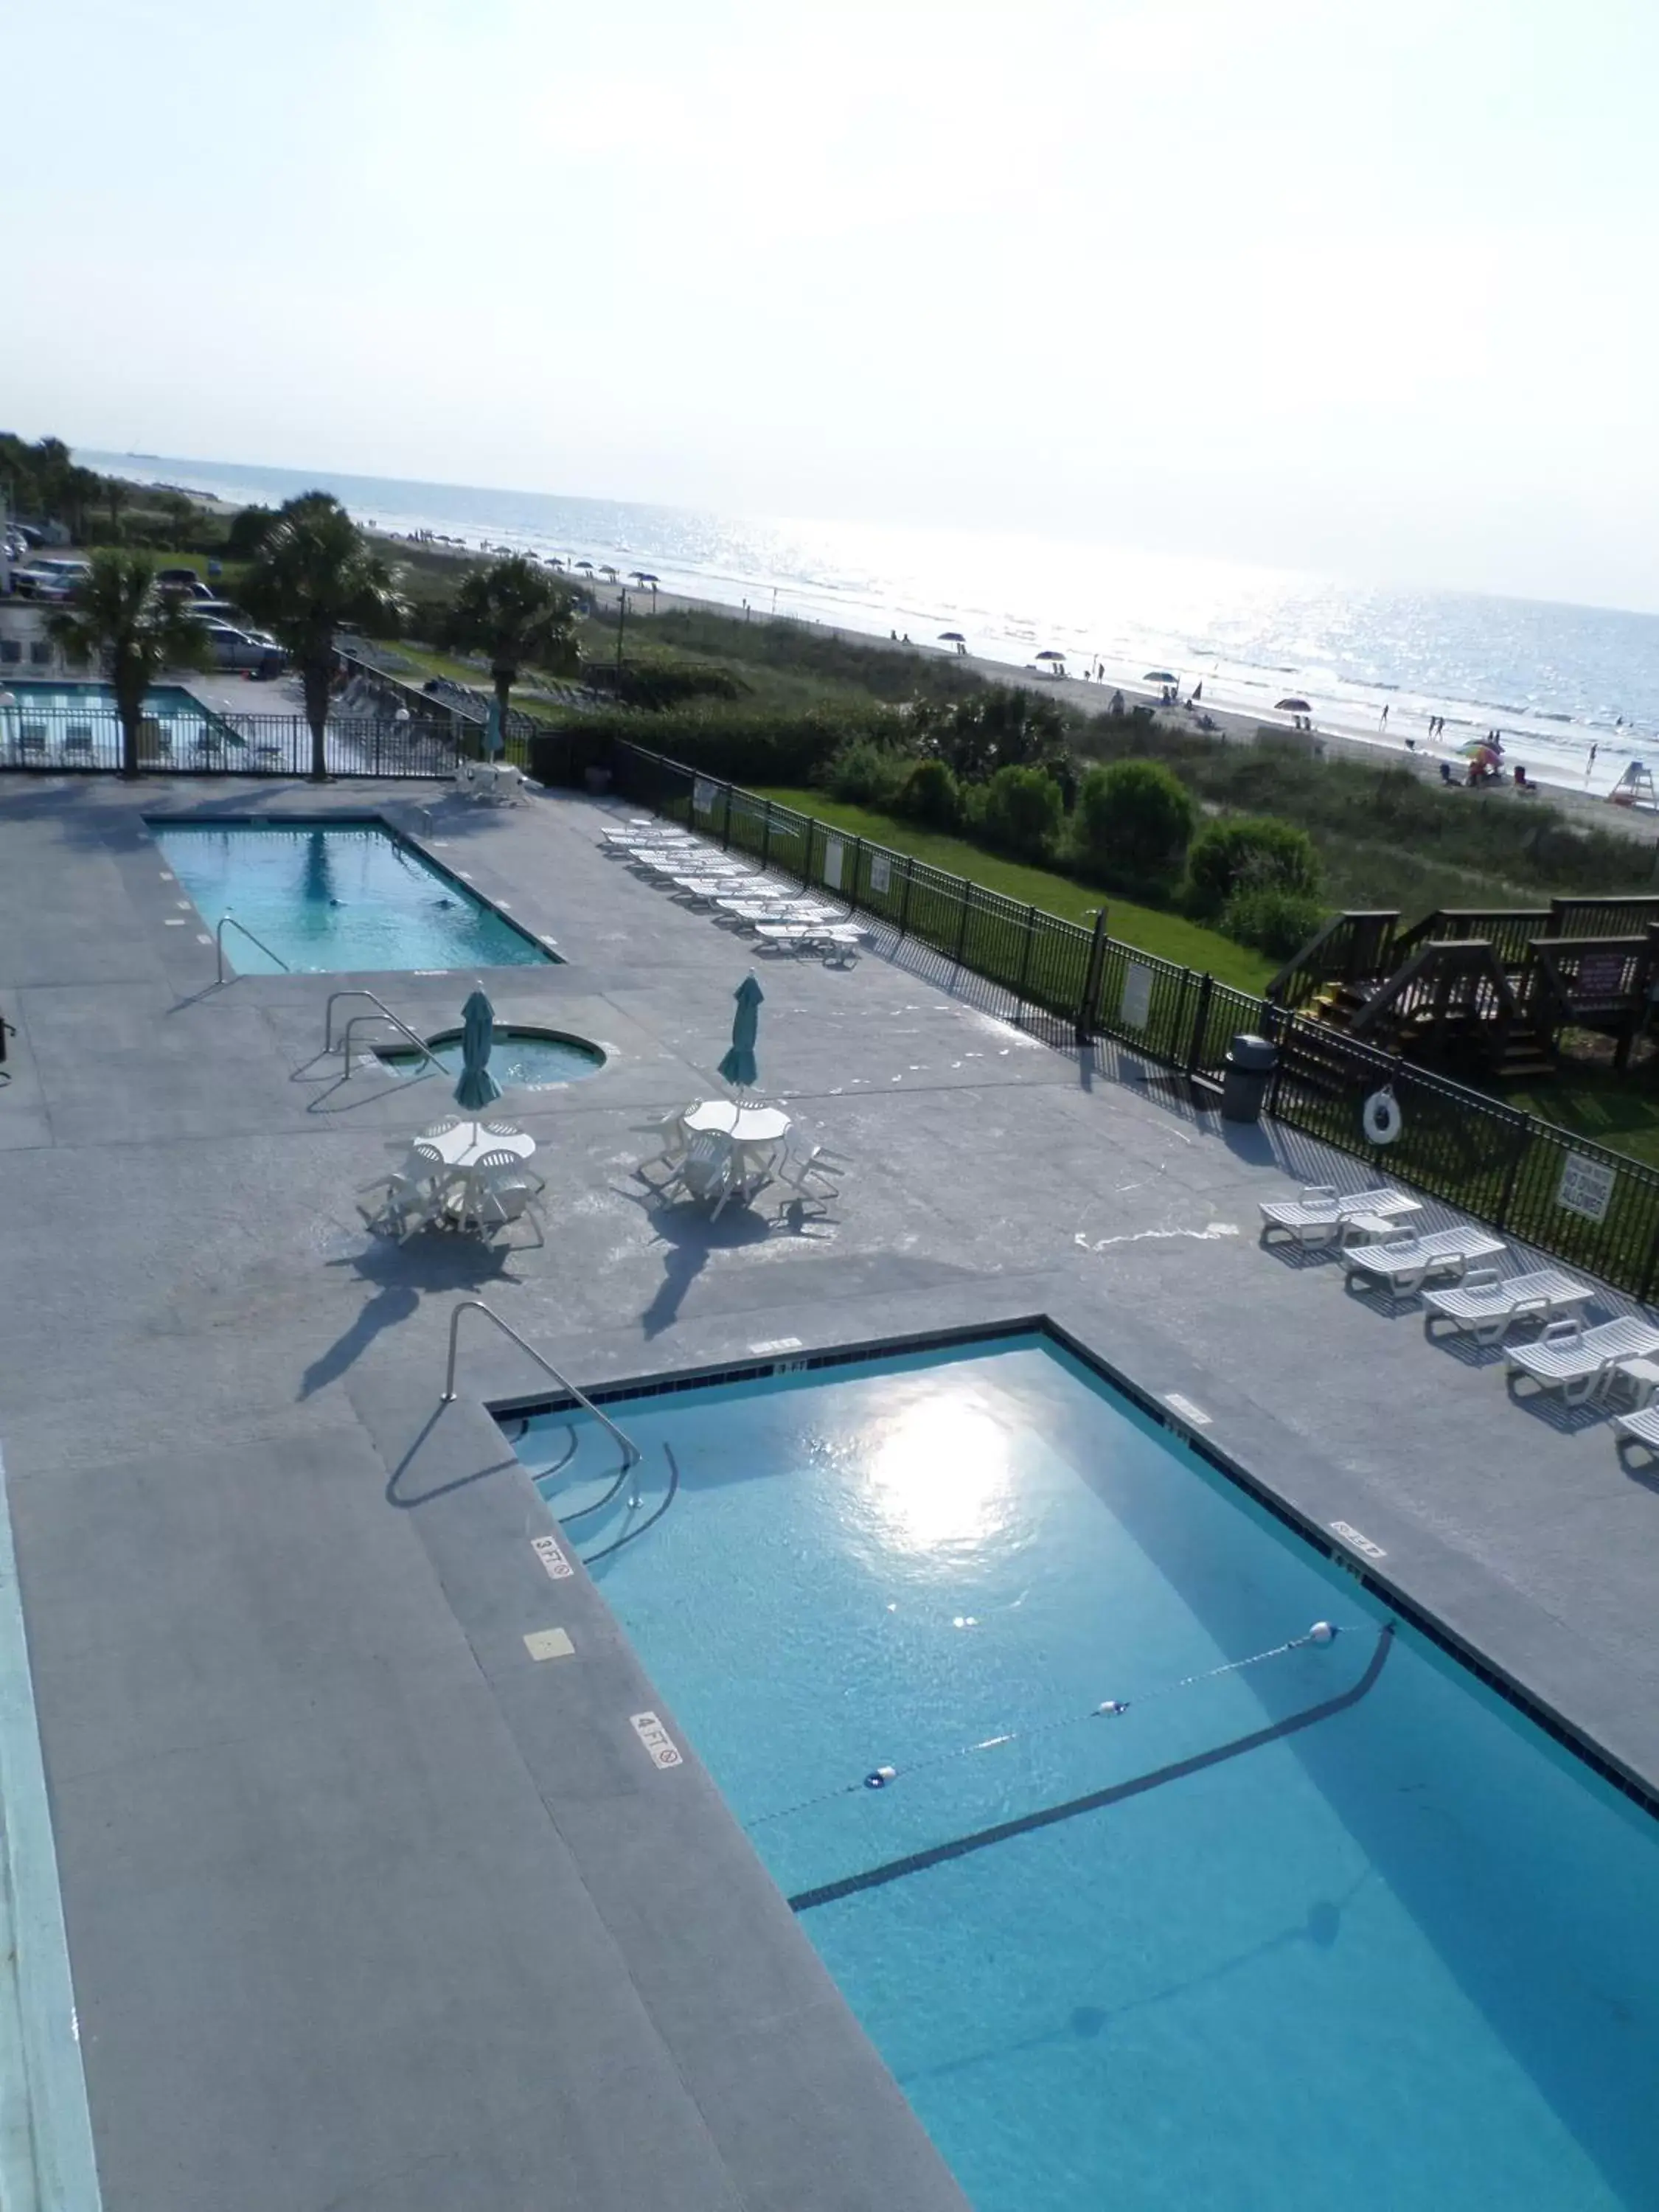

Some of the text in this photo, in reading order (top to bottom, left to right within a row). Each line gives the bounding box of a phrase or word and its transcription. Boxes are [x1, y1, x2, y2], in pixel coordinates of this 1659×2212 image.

[537, 1540, 562, 1563] 3 FT
[638, 1718, 669, 1747] 4 FT
